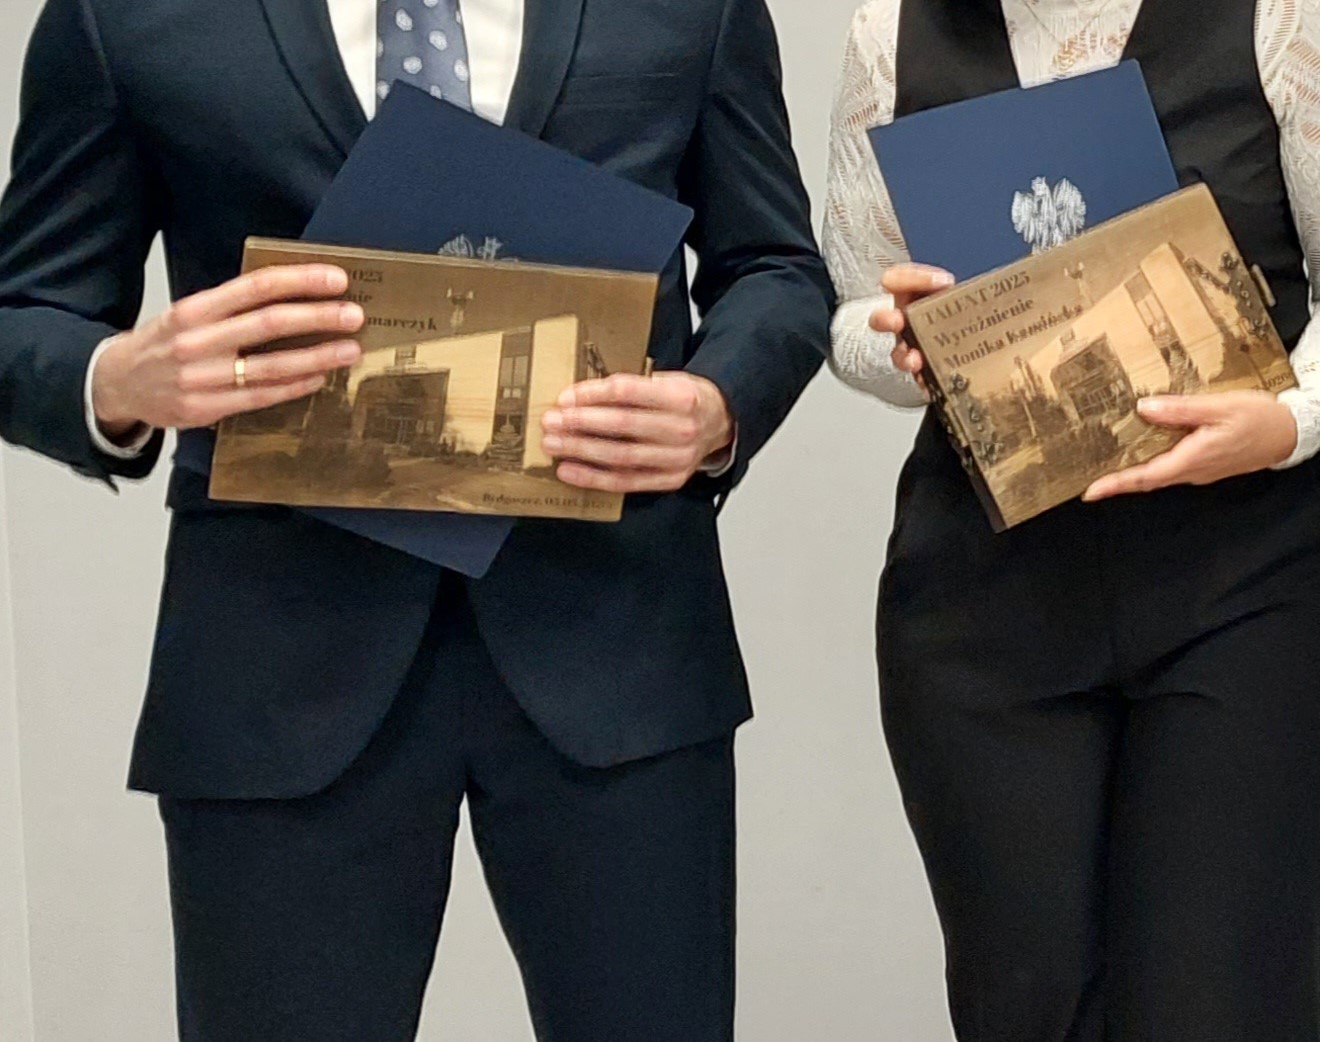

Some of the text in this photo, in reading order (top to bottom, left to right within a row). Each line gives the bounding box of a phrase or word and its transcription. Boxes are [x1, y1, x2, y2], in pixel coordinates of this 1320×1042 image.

[924, 271, 1031, 326] TALENT 2025
[367, 317, 438, 333] marczyk
[944, 338, 1005, 369] Monika
